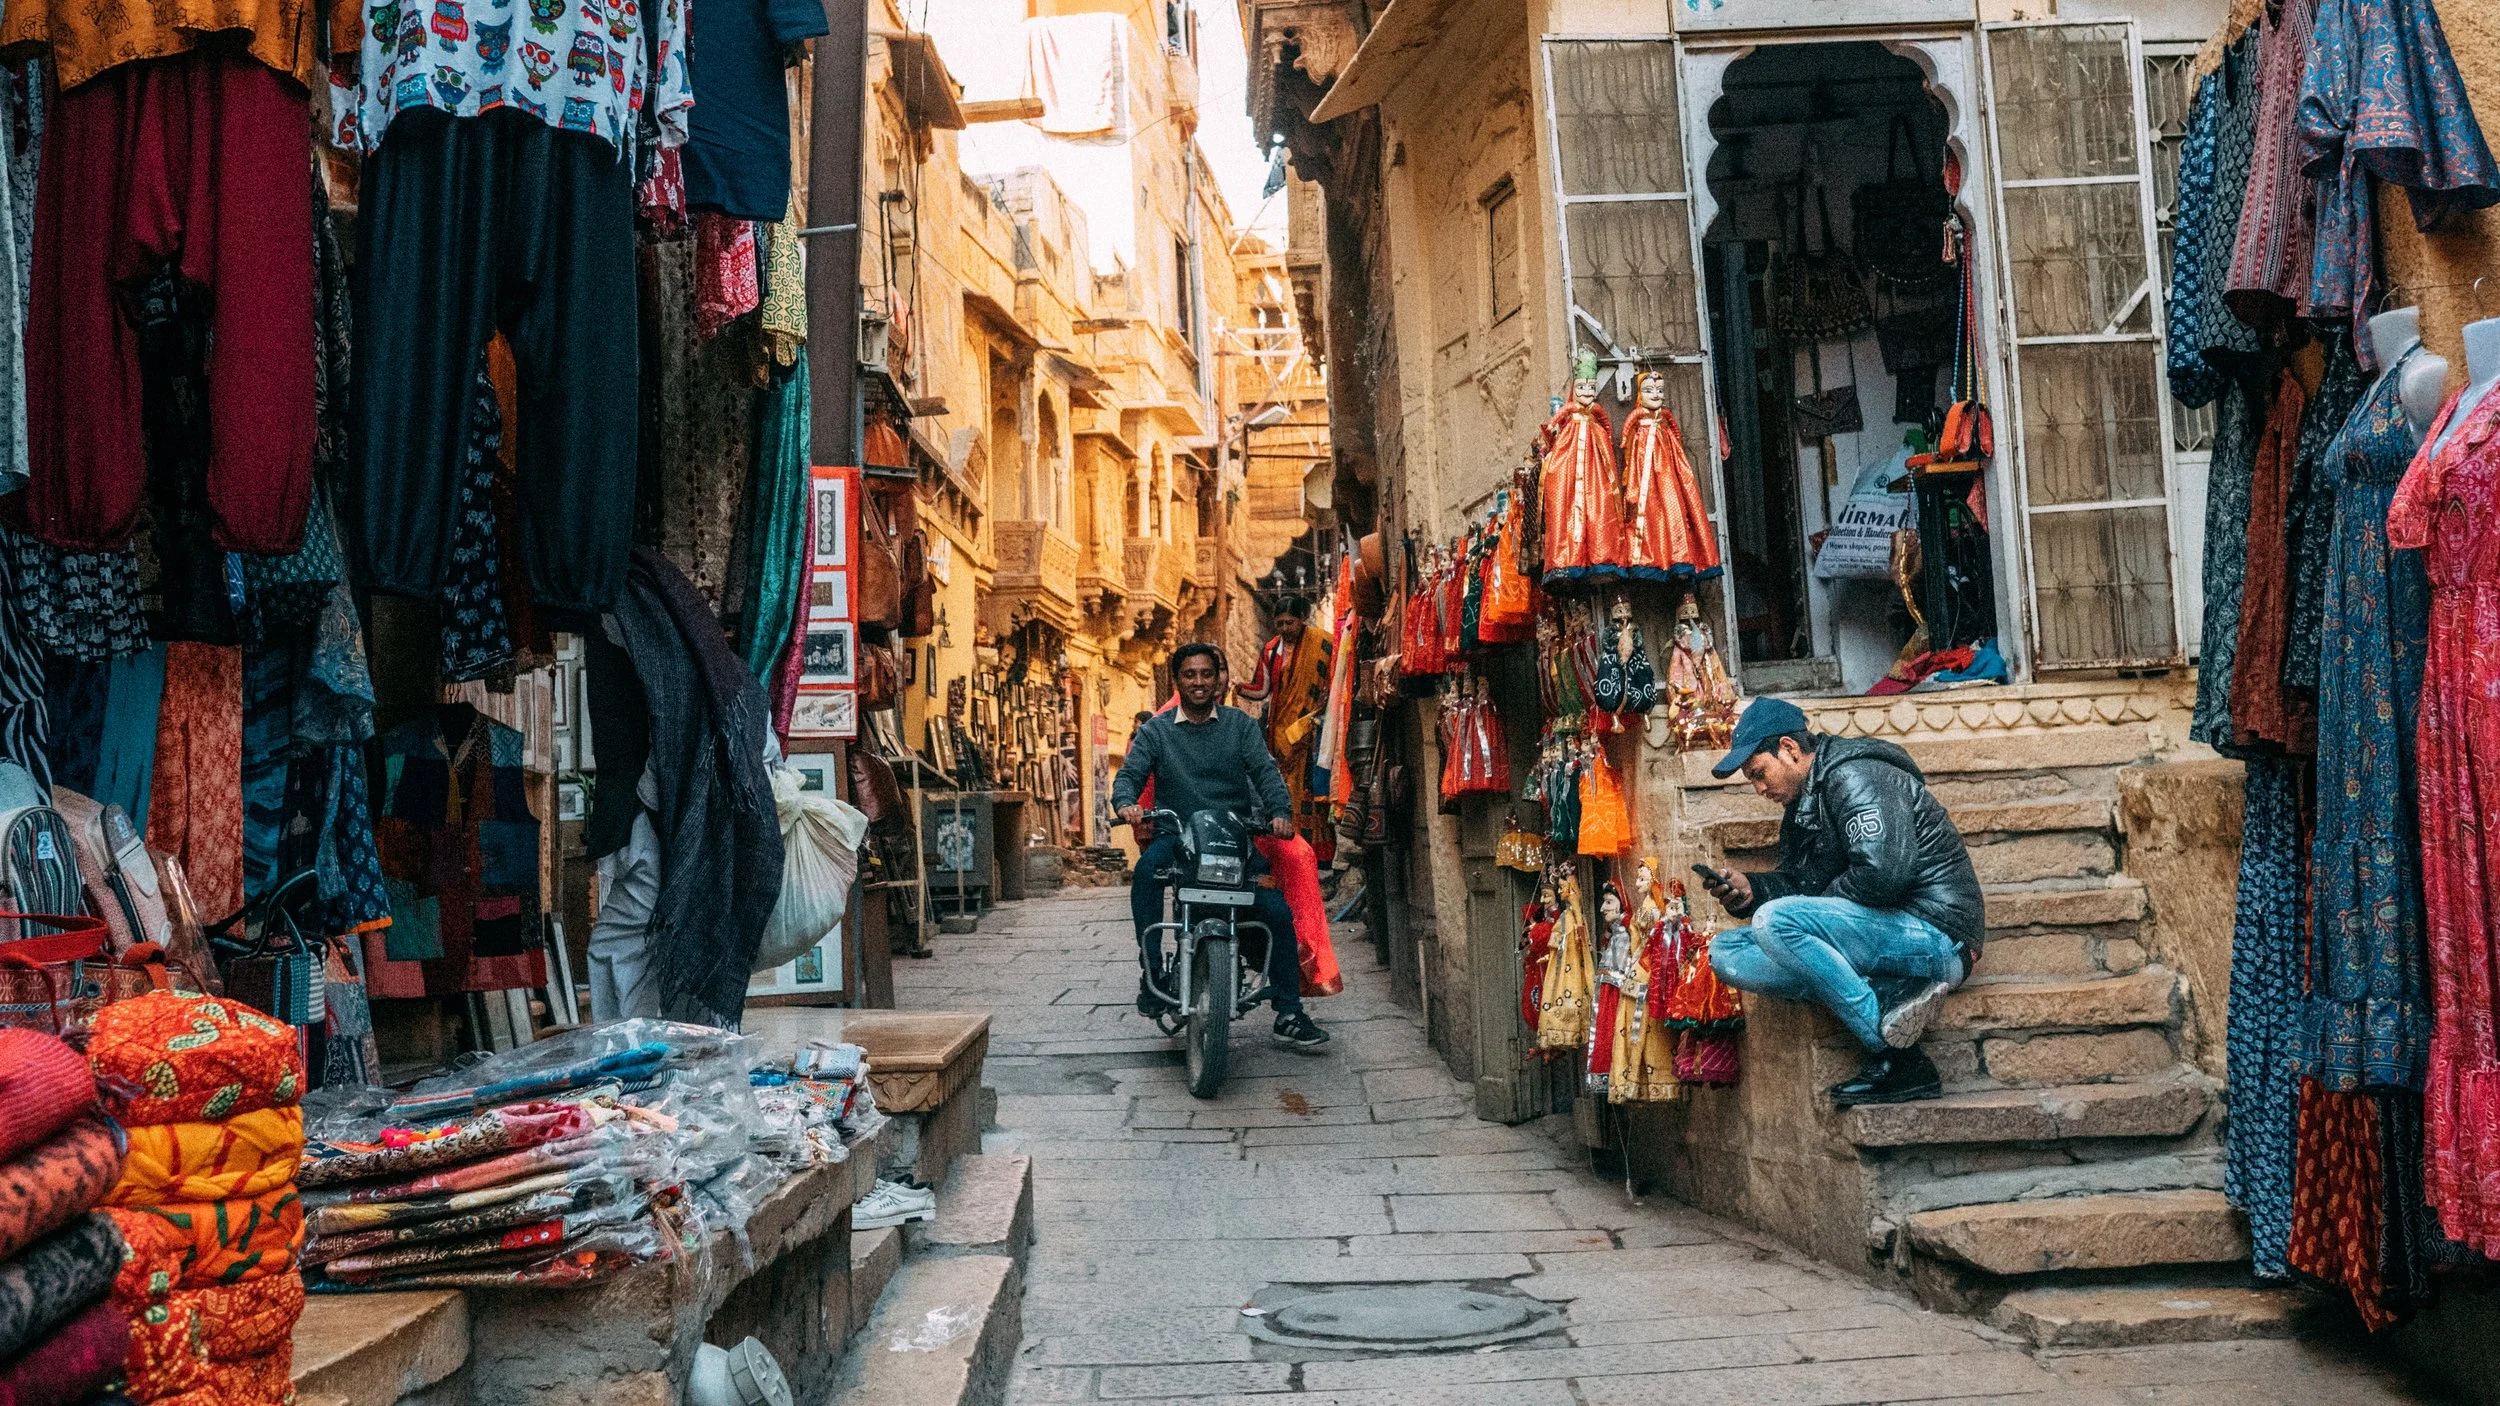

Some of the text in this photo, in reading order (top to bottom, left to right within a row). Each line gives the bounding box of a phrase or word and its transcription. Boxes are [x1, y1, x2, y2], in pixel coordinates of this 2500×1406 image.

[1830, 526, 1856, 537] ollection
[1857, 527, 1864, 537] &
[1845, 808, 1883, 843] 25
